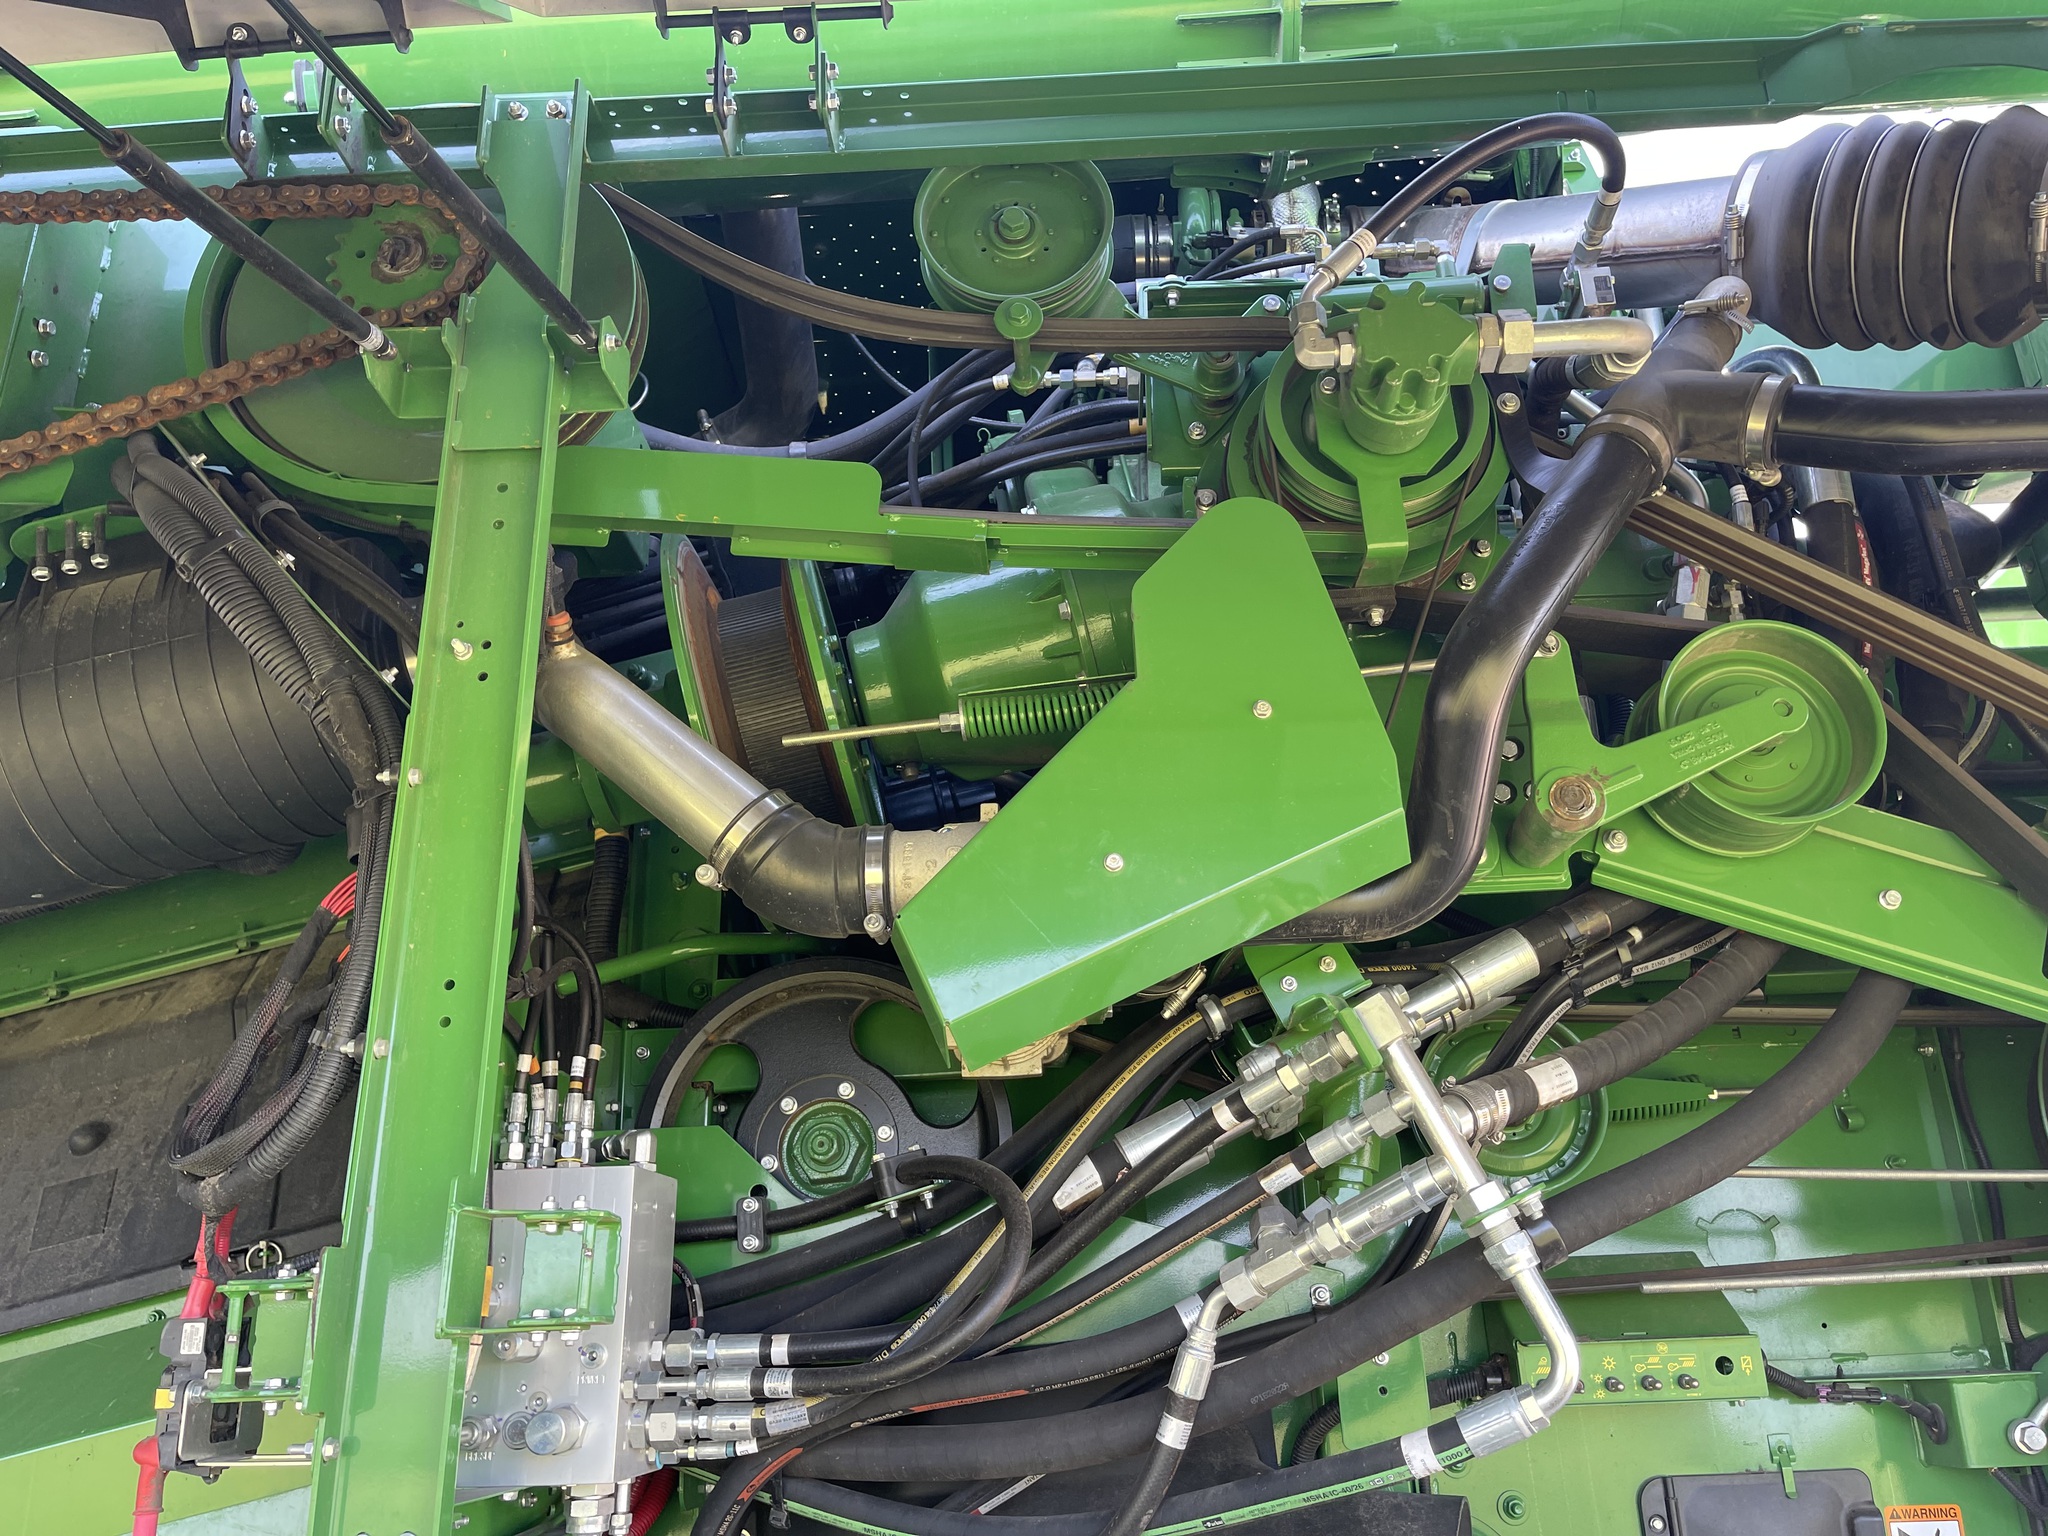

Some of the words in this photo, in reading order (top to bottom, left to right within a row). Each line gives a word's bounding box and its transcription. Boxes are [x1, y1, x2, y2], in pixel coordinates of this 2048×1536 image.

[1554, 1001, 1571, 1019] MSHA
[1110, 1076, 1126, 1092] MSHA
[1075, 1116, 1090, 1133] FRAS
[1047, 1137, 1073, 1167] ABRASION
[1303, 1491, 1329, 1504] MSHA
[1329, 1483, 1364, 1499] IC-40/26
[1901, 1507, 1958, 1519] WARNING
